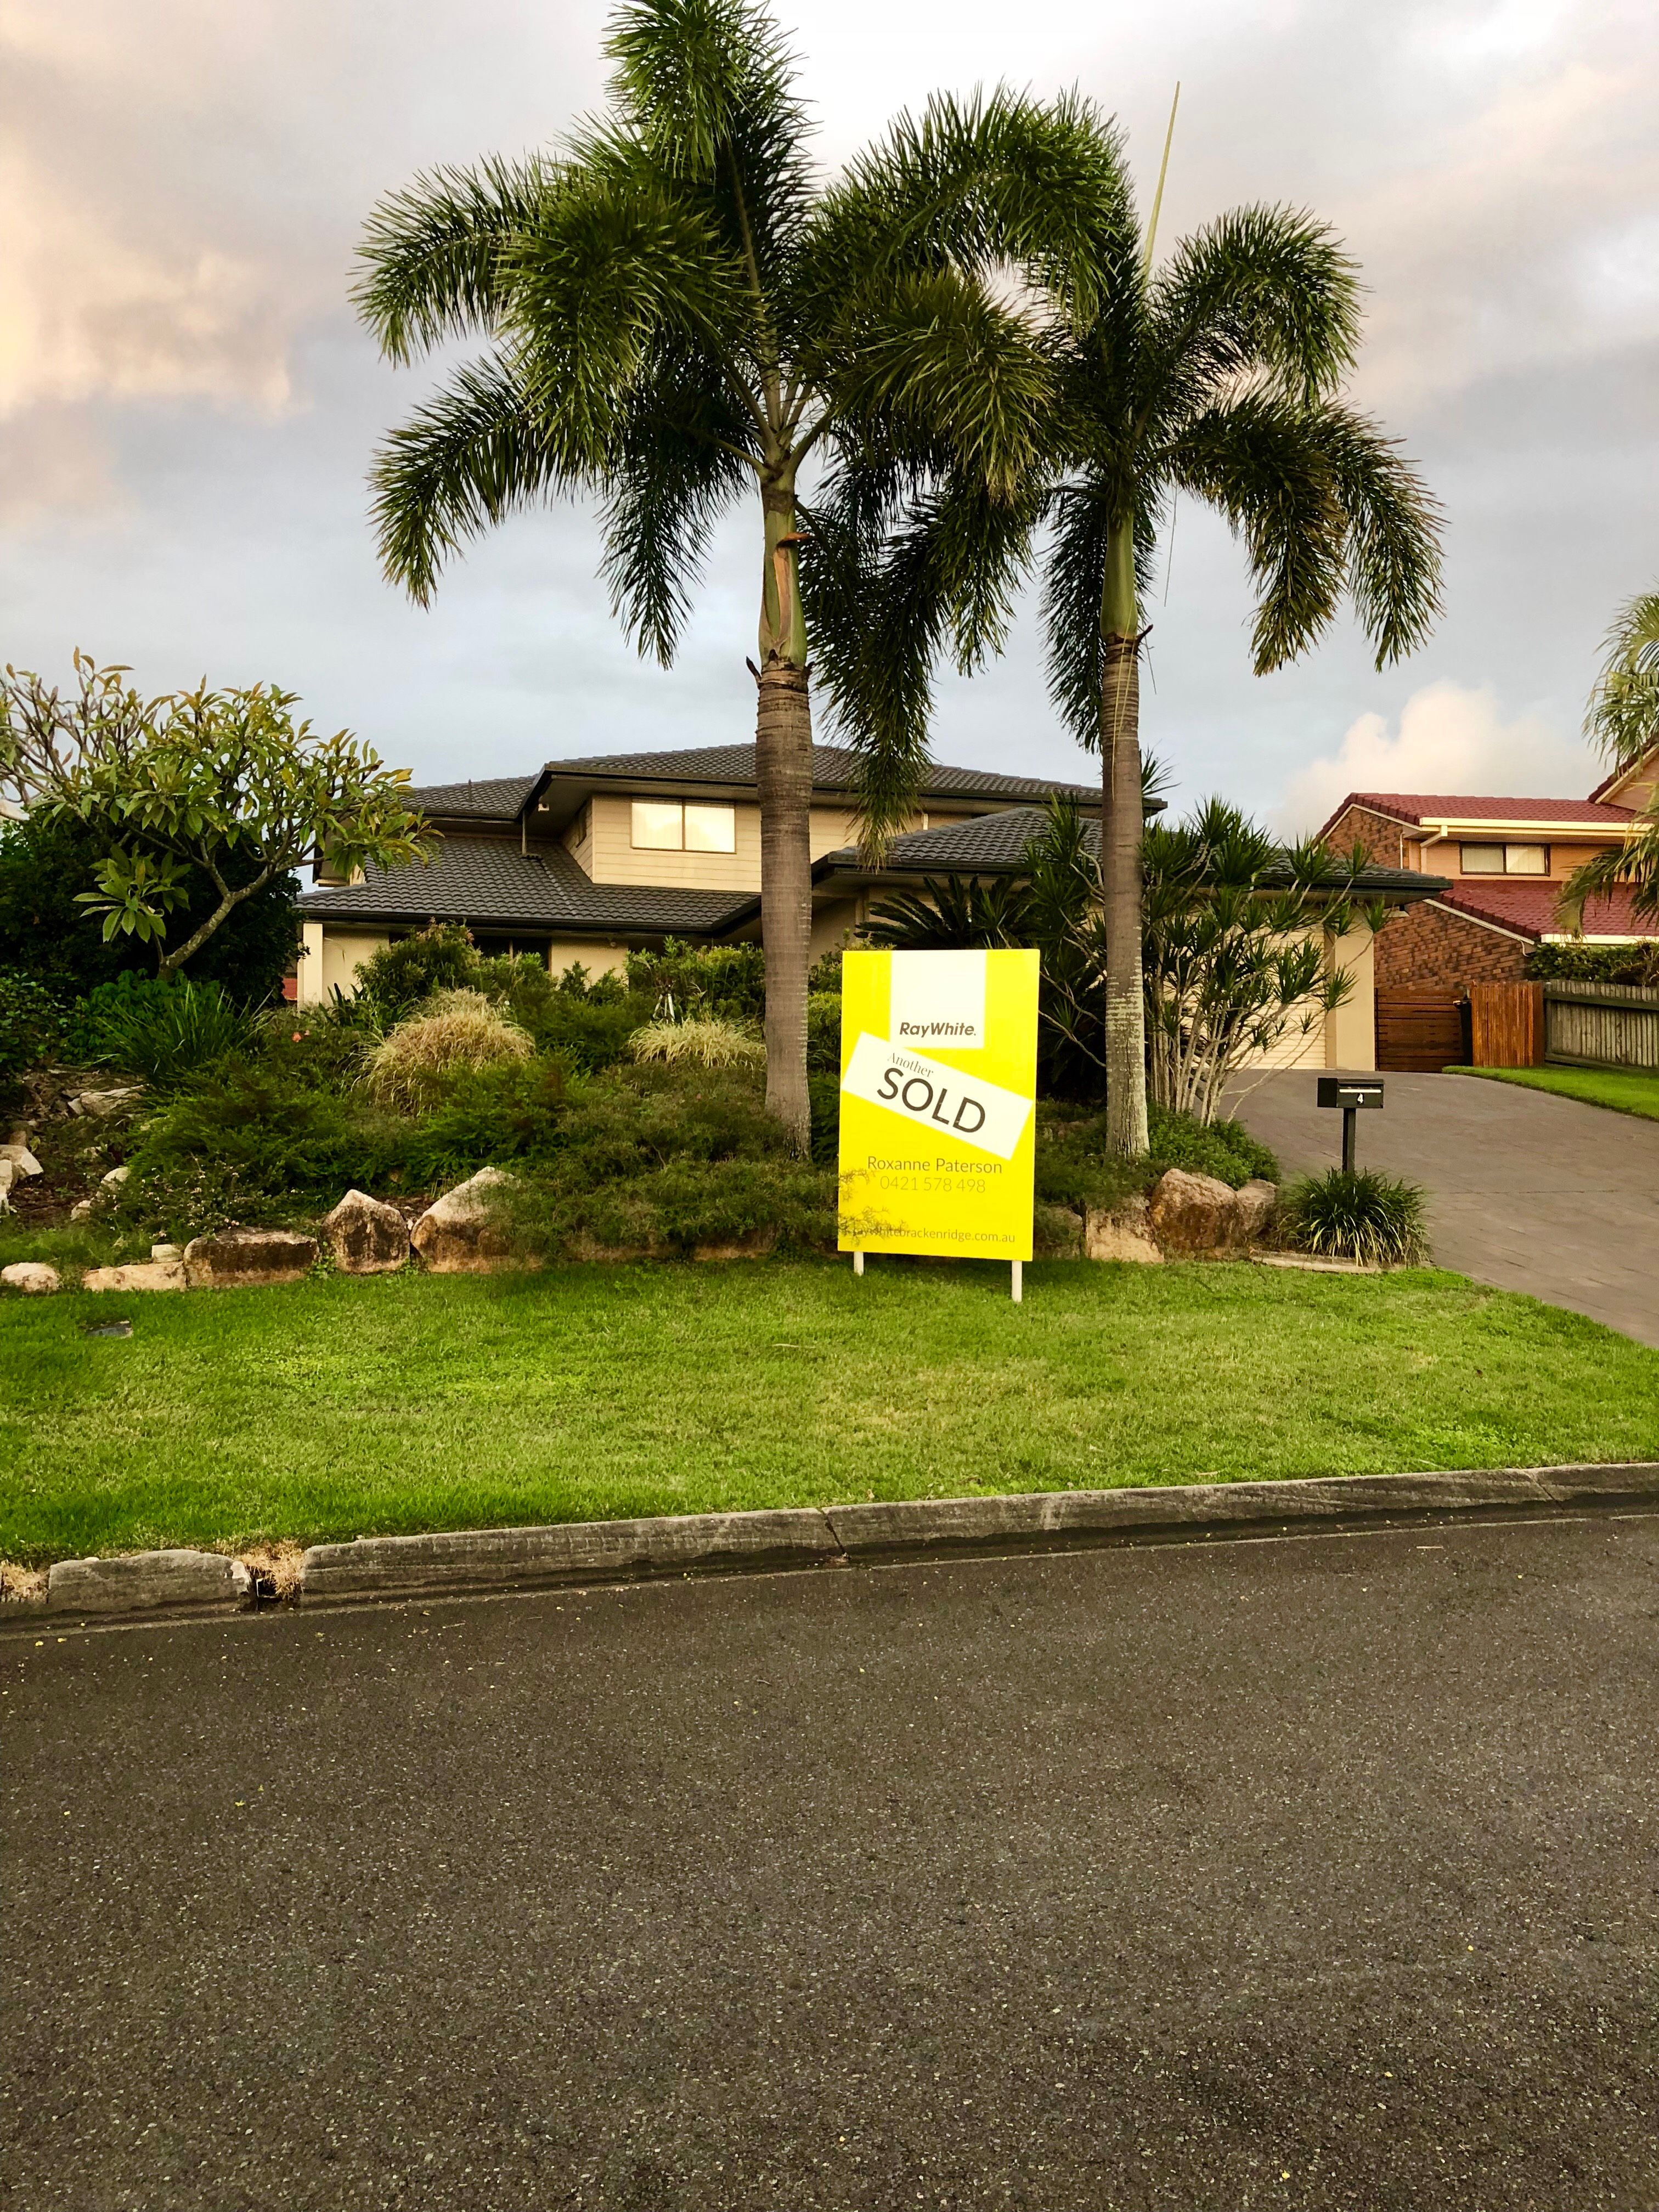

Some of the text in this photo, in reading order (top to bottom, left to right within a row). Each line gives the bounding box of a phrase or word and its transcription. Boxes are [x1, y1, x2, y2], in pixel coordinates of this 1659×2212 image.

[887, 1052, 934, 1077] Another
[877, 1068, 986, 1133] SOLD
[1357, 1093, 1363, 1104] 4
[867, 1156, 1002, 1174] Roxanne Paterson
[880, 1175, 986, 1193] 0421 578 498
[853, 1226, 1015, 1243] yhitebrackenridge.com.au
